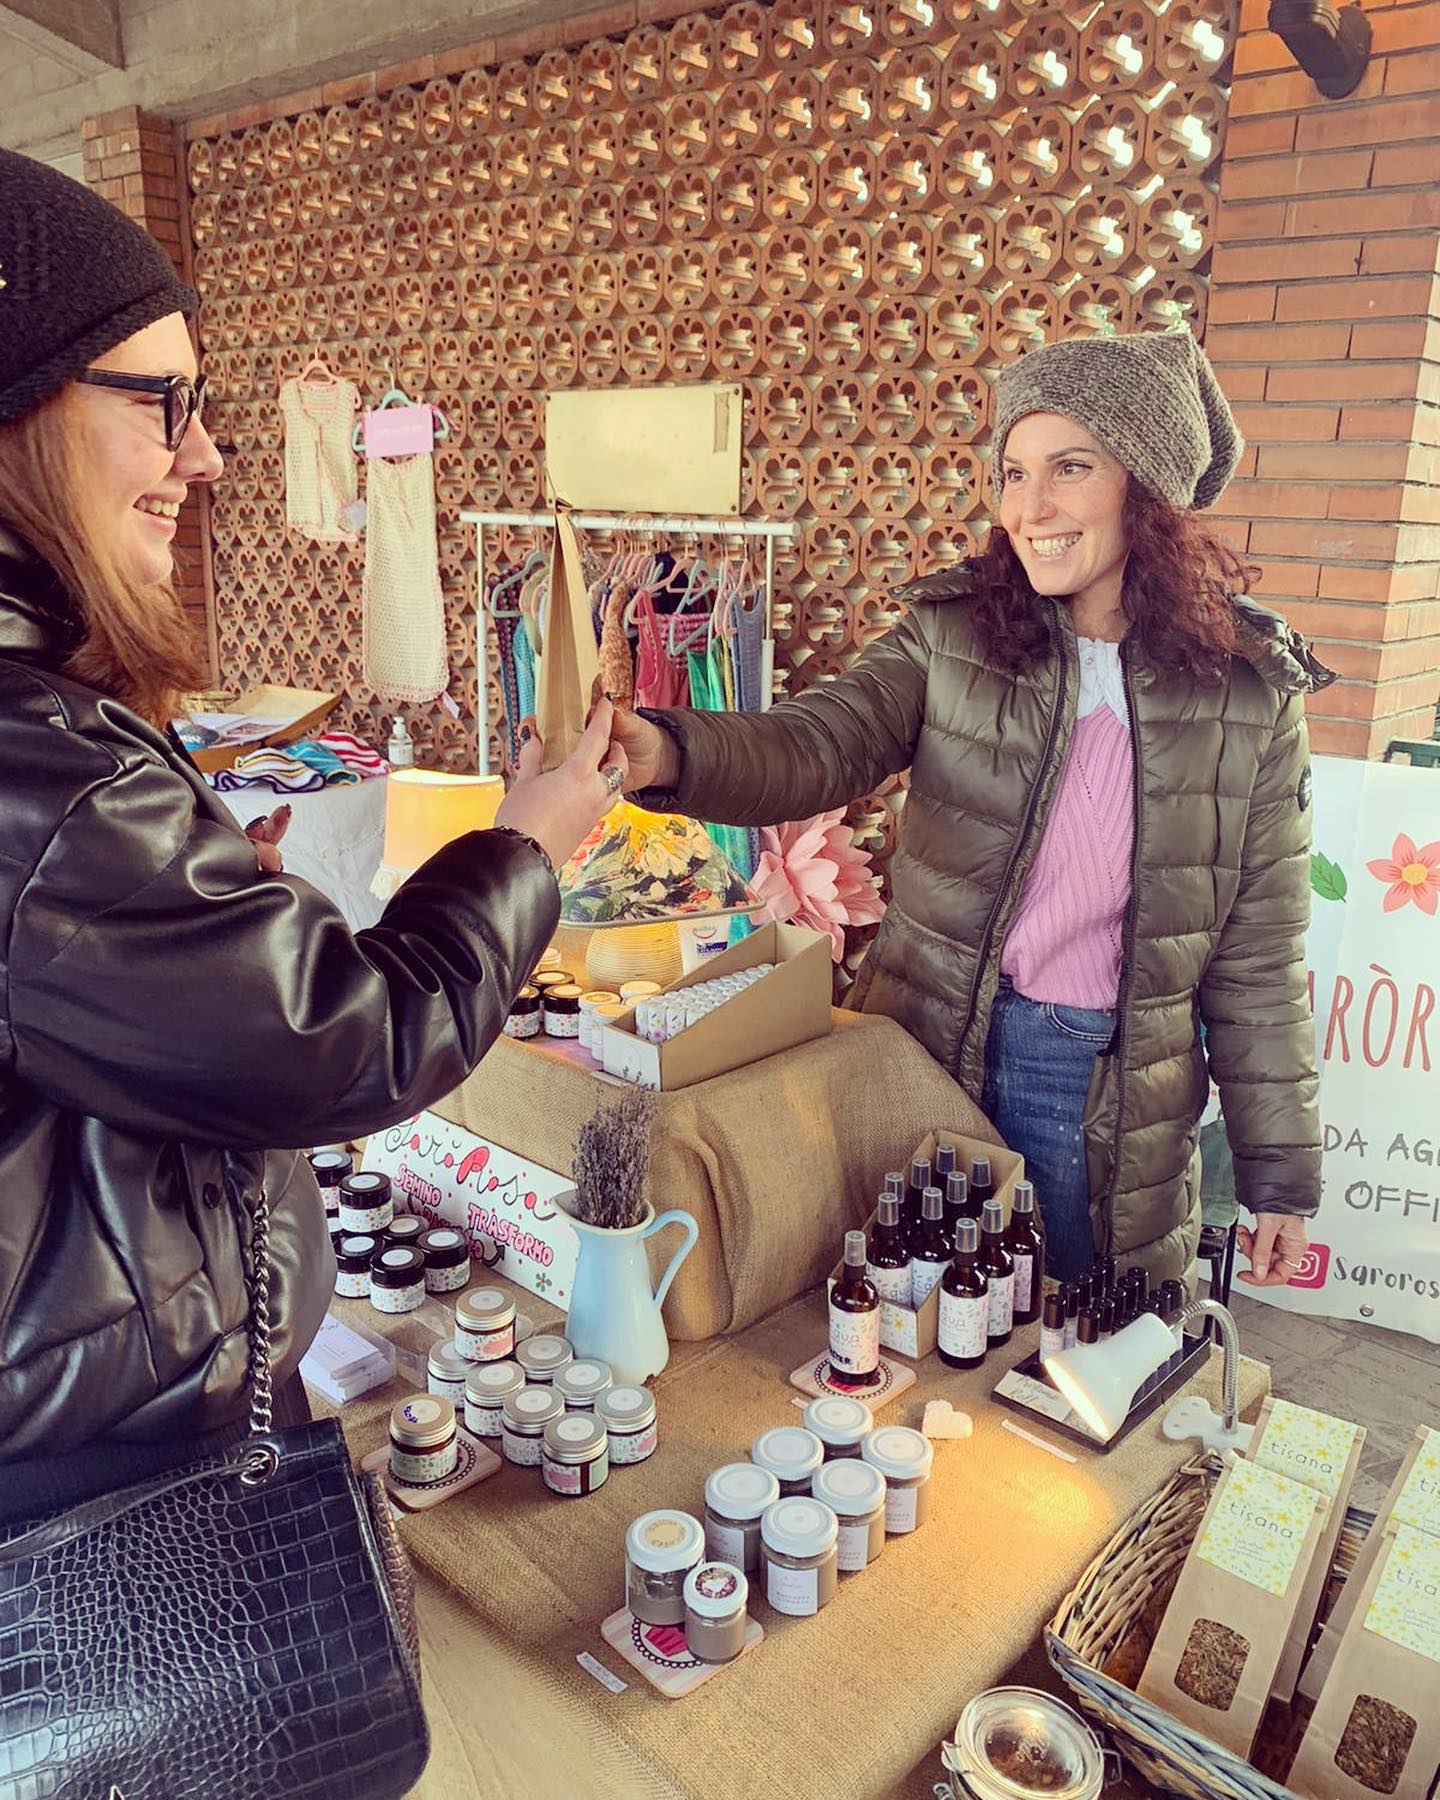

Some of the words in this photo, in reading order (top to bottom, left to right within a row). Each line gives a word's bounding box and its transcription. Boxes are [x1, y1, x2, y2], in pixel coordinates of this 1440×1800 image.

[1324, 1124, 1368, 1157] DA
[393, 1163, 442, 1207] SEMINO
[1345, 1181, 1439, 1222] OFFI
[468, 1202, 554, 1267] TRASFORMO
[1271, 1442, 1332, 1474] tisana
[1230, 1502, 1293, 1538] tisana
